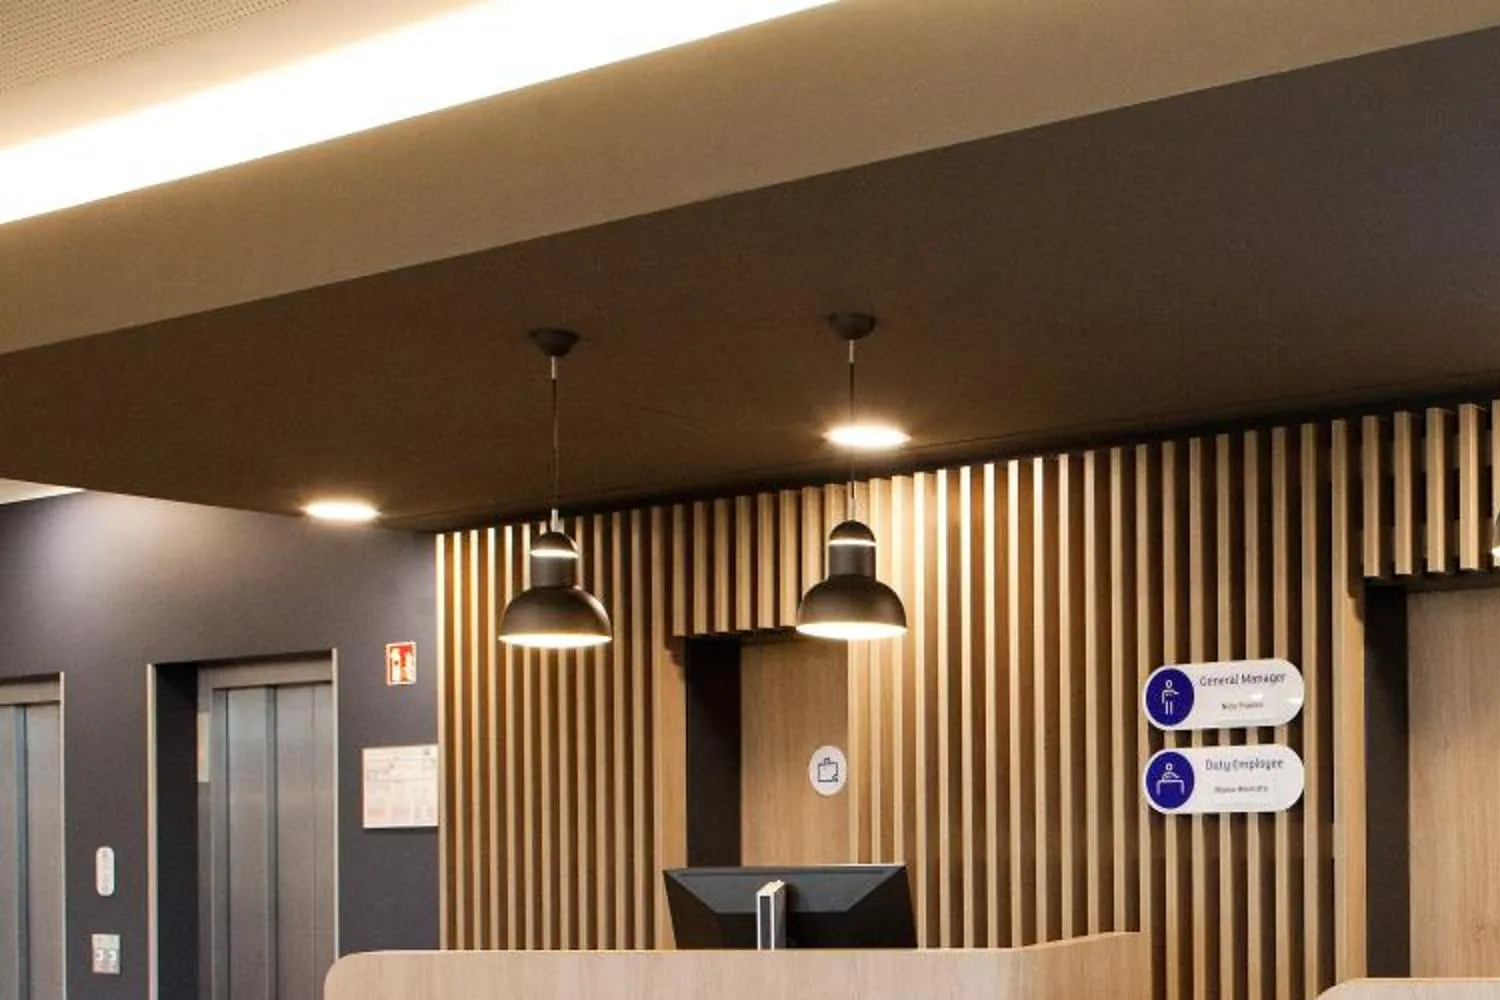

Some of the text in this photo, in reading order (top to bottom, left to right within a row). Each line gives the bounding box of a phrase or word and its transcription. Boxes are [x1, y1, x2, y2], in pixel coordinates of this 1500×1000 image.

[1200, 672, 1286, 686] General Manager
[1205, 757, 1284, 772] Duty Employee
